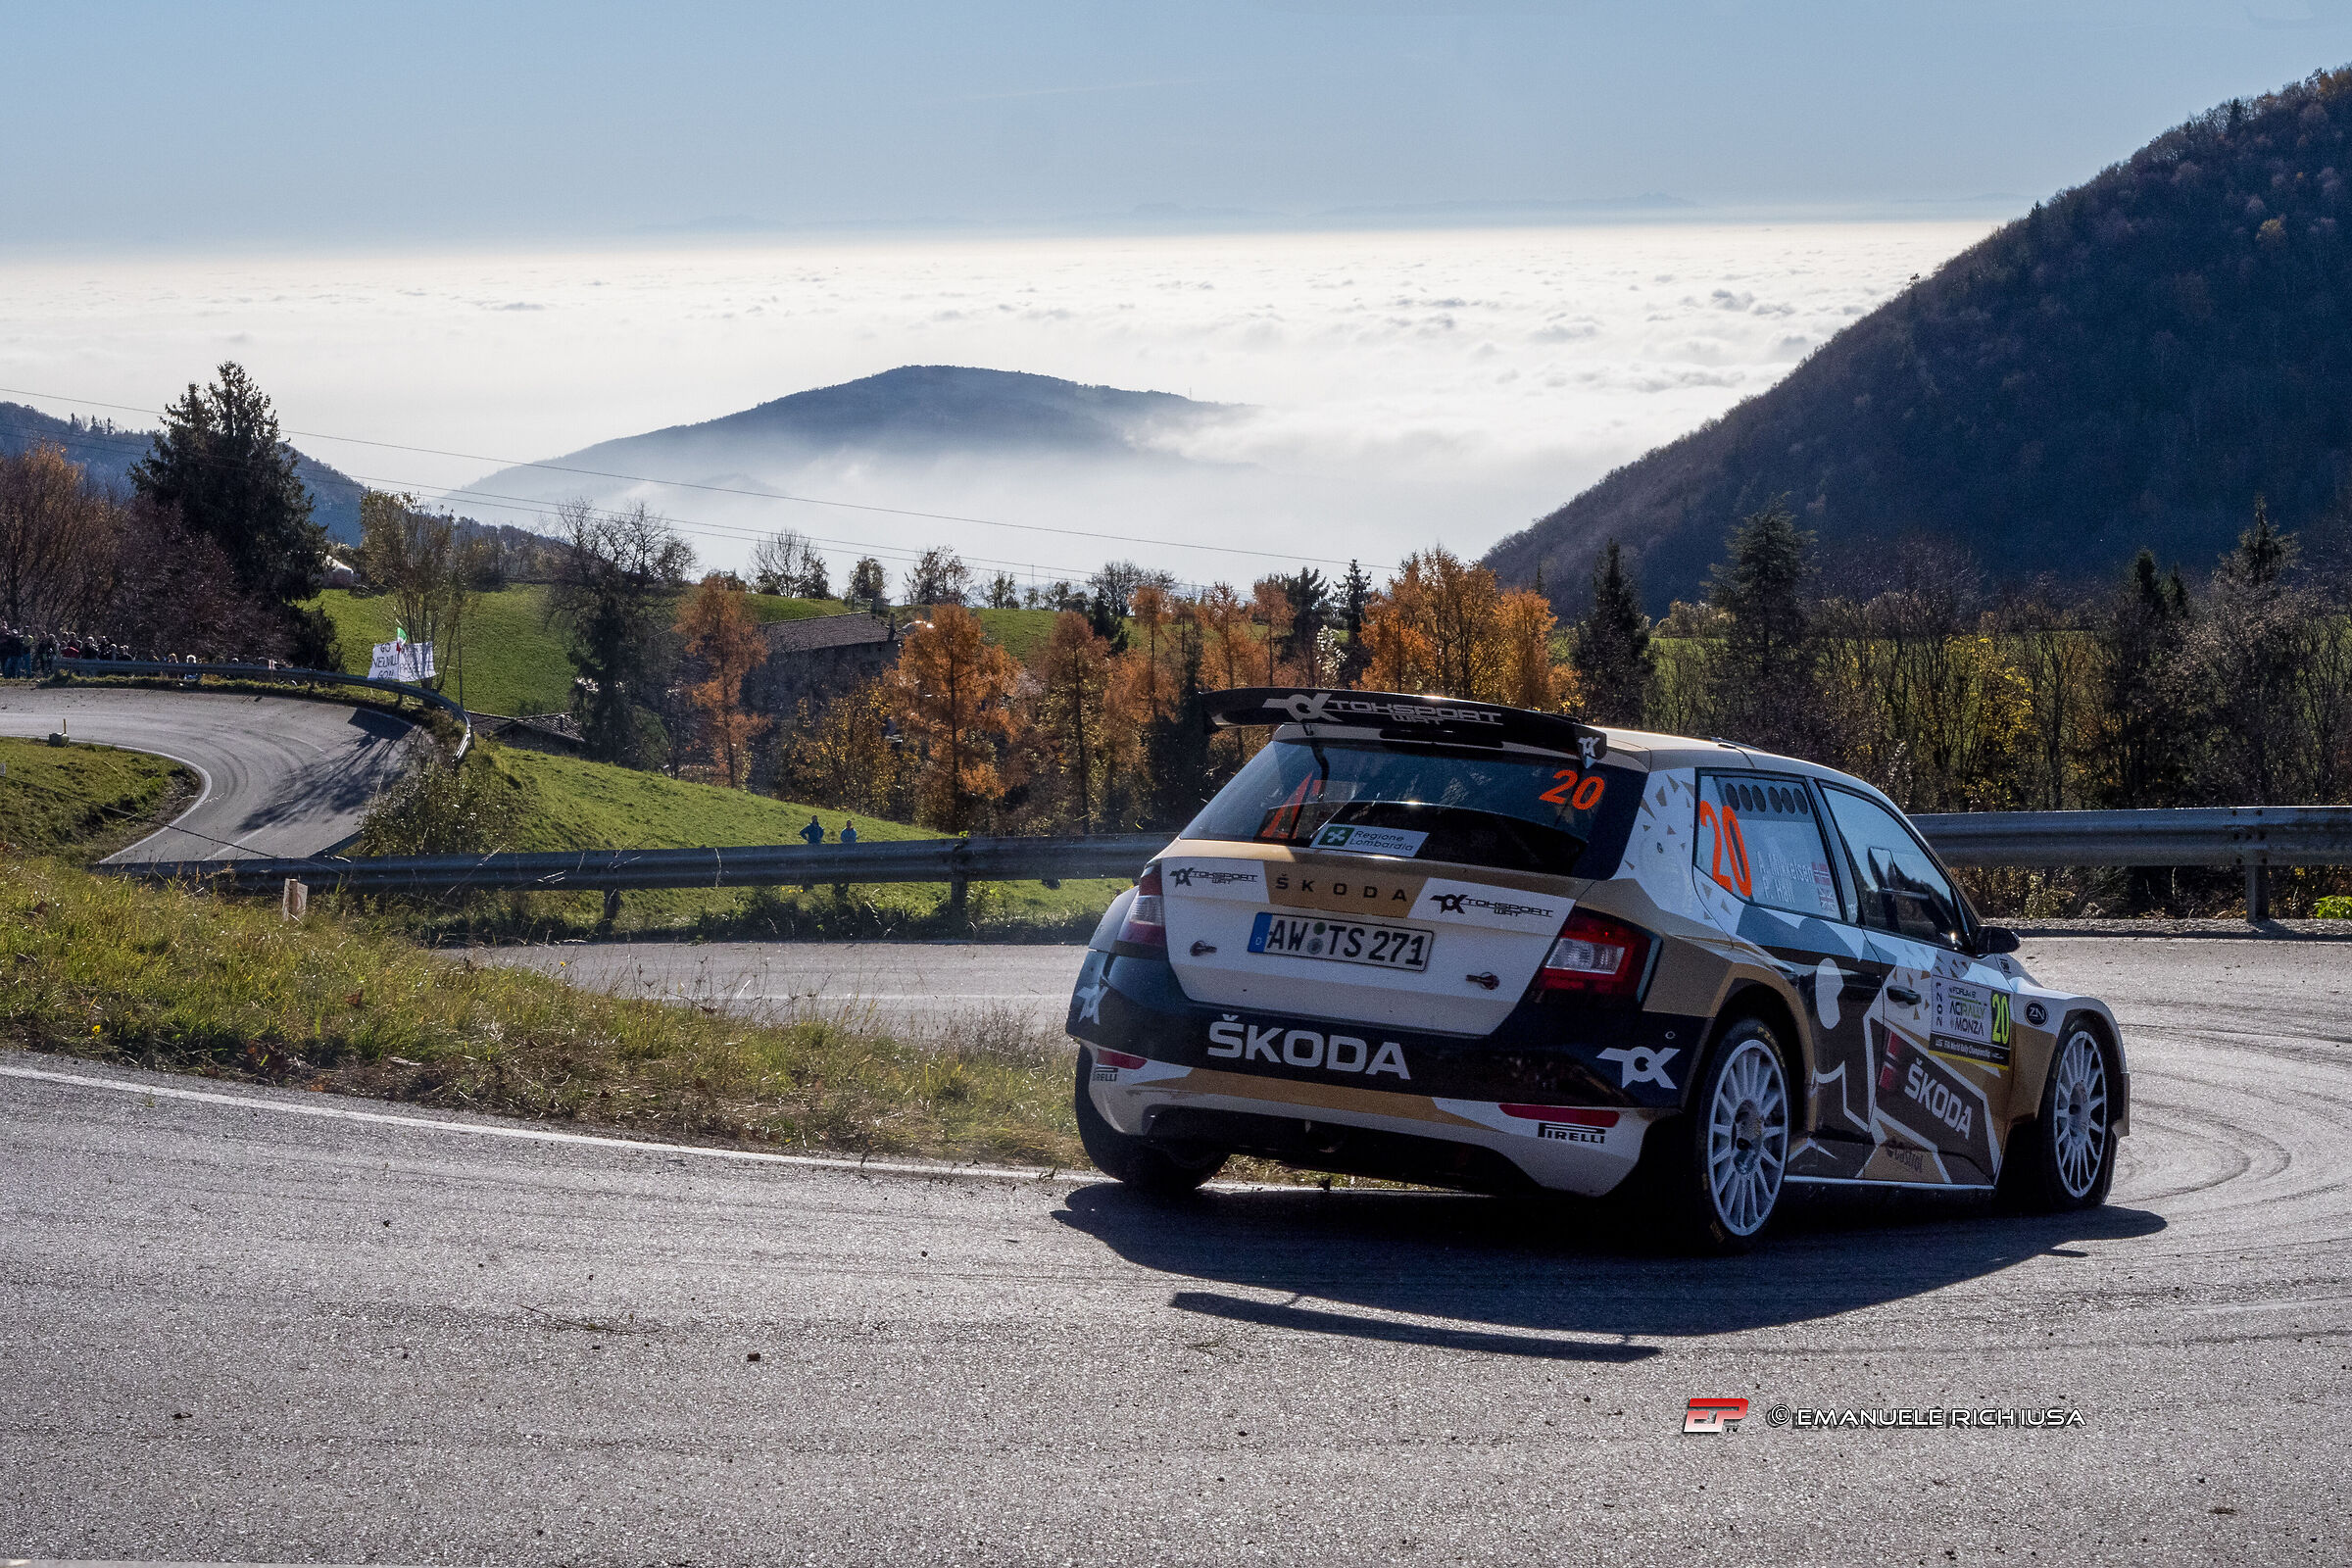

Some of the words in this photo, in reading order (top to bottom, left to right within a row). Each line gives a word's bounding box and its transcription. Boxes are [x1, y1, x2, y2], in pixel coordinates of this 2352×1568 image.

[1327, 700, 1502, 723] TOKSPORT
[1539, 769, 1605, 810] 20
[1349, 838, 1413, 852] Lombardia
[1353, 830, 1404, 842] Regione
[1699, 800, 1752, 897] 20
[1275, 874, 1407, 903] ŠKODA
[1267, 919, 1309, 951] AW
[1329, 924, 1366, 958] TS
[1368, 930, 1426, 965] 271
[1954, 1017, 1984, 1037] MONZA
[1991, 993, 2010, 1045] 20
[1207, 1014, 1411, 1080] ŠKODA
[1904, 1058, 1974, 1141] ŠKODA
[1539, 1122, 1606, 1144] PIRELLI
